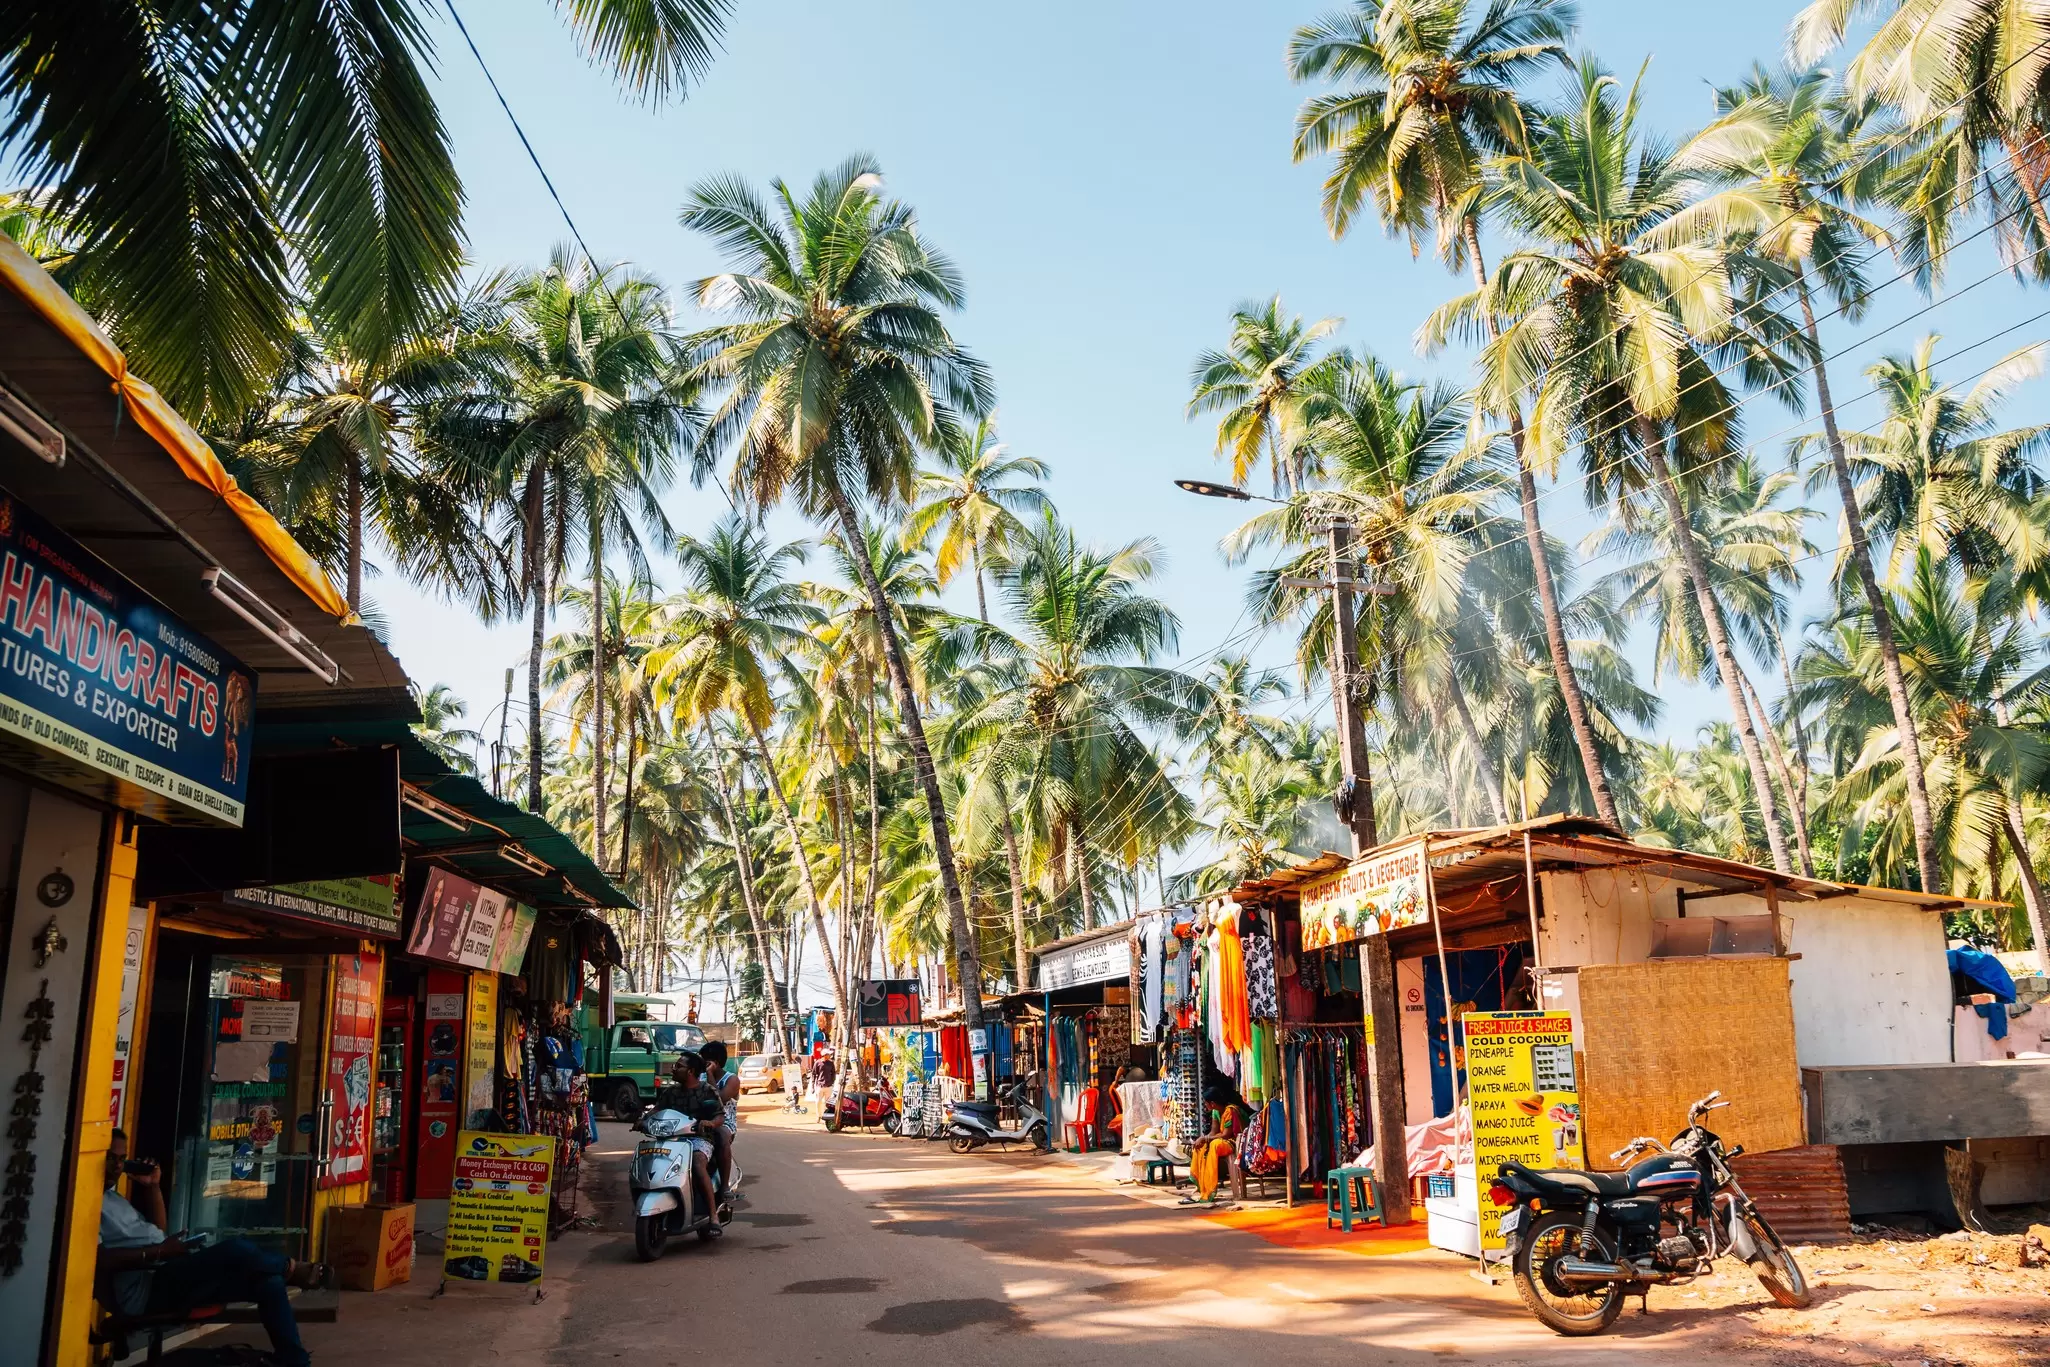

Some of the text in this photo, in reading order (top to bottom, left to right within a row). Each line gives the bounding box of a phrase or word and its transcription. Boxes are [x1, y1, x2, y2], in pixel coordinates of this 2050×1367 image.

[158, 623, 178, 649] Mob:
[0, 551, 219, 737] HANDICRAFTS
[74, 679, 87, 708] &
[92, 689, 178, 752] EXPORTER
[22, 713, 33, 730] OF
[35, 719, 50, 739] OLD
[135, 764, 165, 788] TELSCOPE
[169, 779, 174, 791] &
[1343, 870, 1367, 896] FRUITS
[1368, 868, 1374, 888] &
[1376, 853, 1419, 885] VEGETABLE
[235, 887, 267, 904] DOMESTIC
[268, 892, 273, 904] &
[274, 893, 317, 914] INTERNATIONAL
[336, 907, 348, 921] RAIL
[348, 911, 353, 922] &
[353, 912, 363, 924] BUS
[363, 914, 378, 928] TICKET
[378, 917, 397, 932] BOOKING
[367, 897, 388, 914] Advance
[480, 898, 498, 918] VITHAL
[1411, 1004, 1425, 1012] SMOKING
[1468, 1018, 1569, 1035] FRESH JUICE & SHAKES
[1471, 1034, 1568, 1046] COLD COCONUT
[1470, 1047, 1514, 1058] PINEAPPLE
[1472, 1065, 1506, 1076] ORANGE
[241, 1082, 287, 1098] CONSULTANTS
[1473, 1082, 1530, 1093] WATER MELON
[1474, 1100, 1506, 1111] PAPAYA
[1476, 1117, 1535, 1129] MANGO JUICE
[210, 1123, 234, 1140] MOBILE
[1477, 1135, 1539, 1147] POMEGRANATE
[1479, 1153, 1541, 1165] MIXED FRUITS
[460, 1158, 546, 1173] Money Exchange TC & CASH
[470, 1169, 534, 1181] Cash On Advance
[456, 1201, 478, 1209] Domestic
[483, 1203, 515, 1211] International
[515, 1205, 529, 1214] Flight
[530, 1206, 546, 1214] Tickets
[491, 1214, 503, 1222] Train
[503, 1216, 523, 1224] Booking
[454, 1223, 488, 1233] Hotel Booking
[453, 1233, 470, 1242] Mobile
[500, 1236, 514, 1244] Cards
[451, 1244, 463, 1252] Bike
